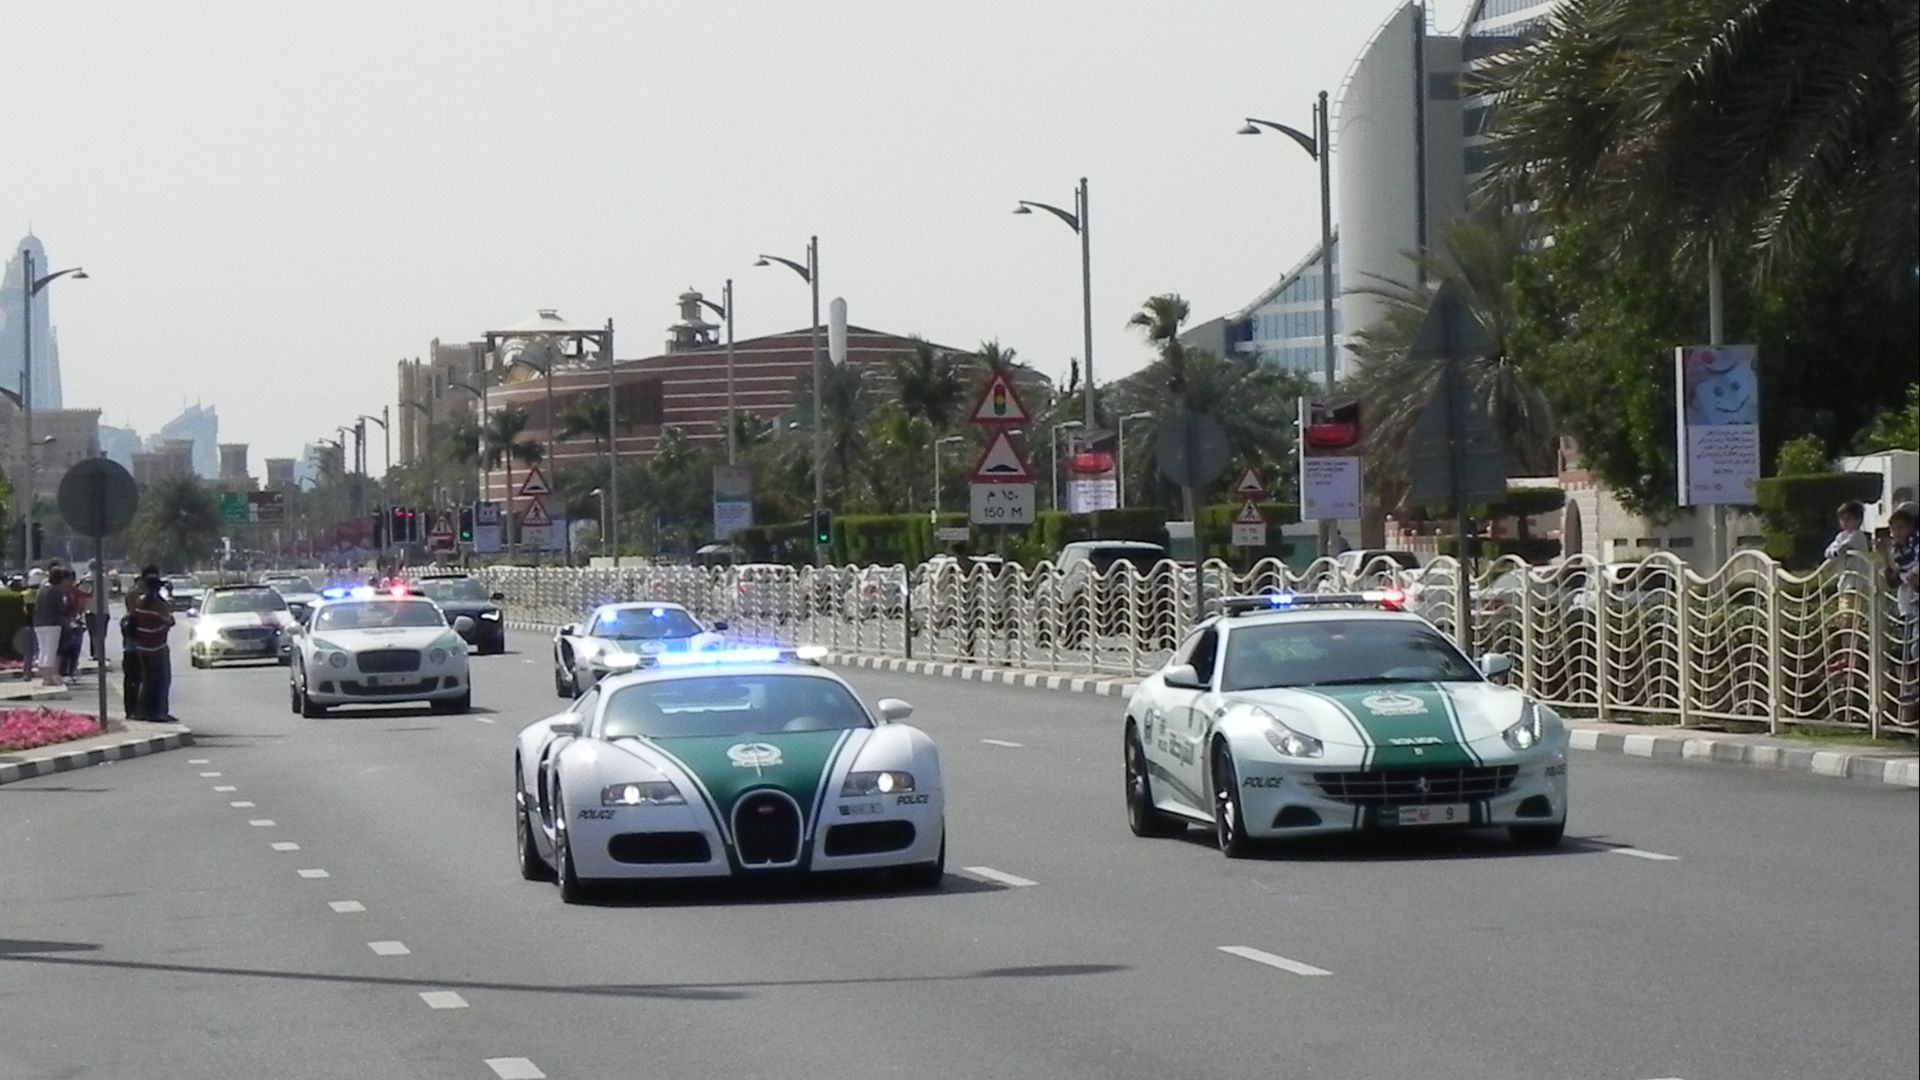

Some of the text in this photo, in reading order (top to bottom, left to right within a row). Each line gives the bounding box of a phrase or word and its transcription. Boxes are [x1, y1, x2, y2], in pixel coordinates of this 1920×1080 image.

[984, 506, 1022, 518] 150 M
[1242, 776, 1284, 788] POLICE
[896, 794, 929, 806] POLICE
[577, 809, 617, 819] POLICE
[1446, 806, 1454, 820] 9
